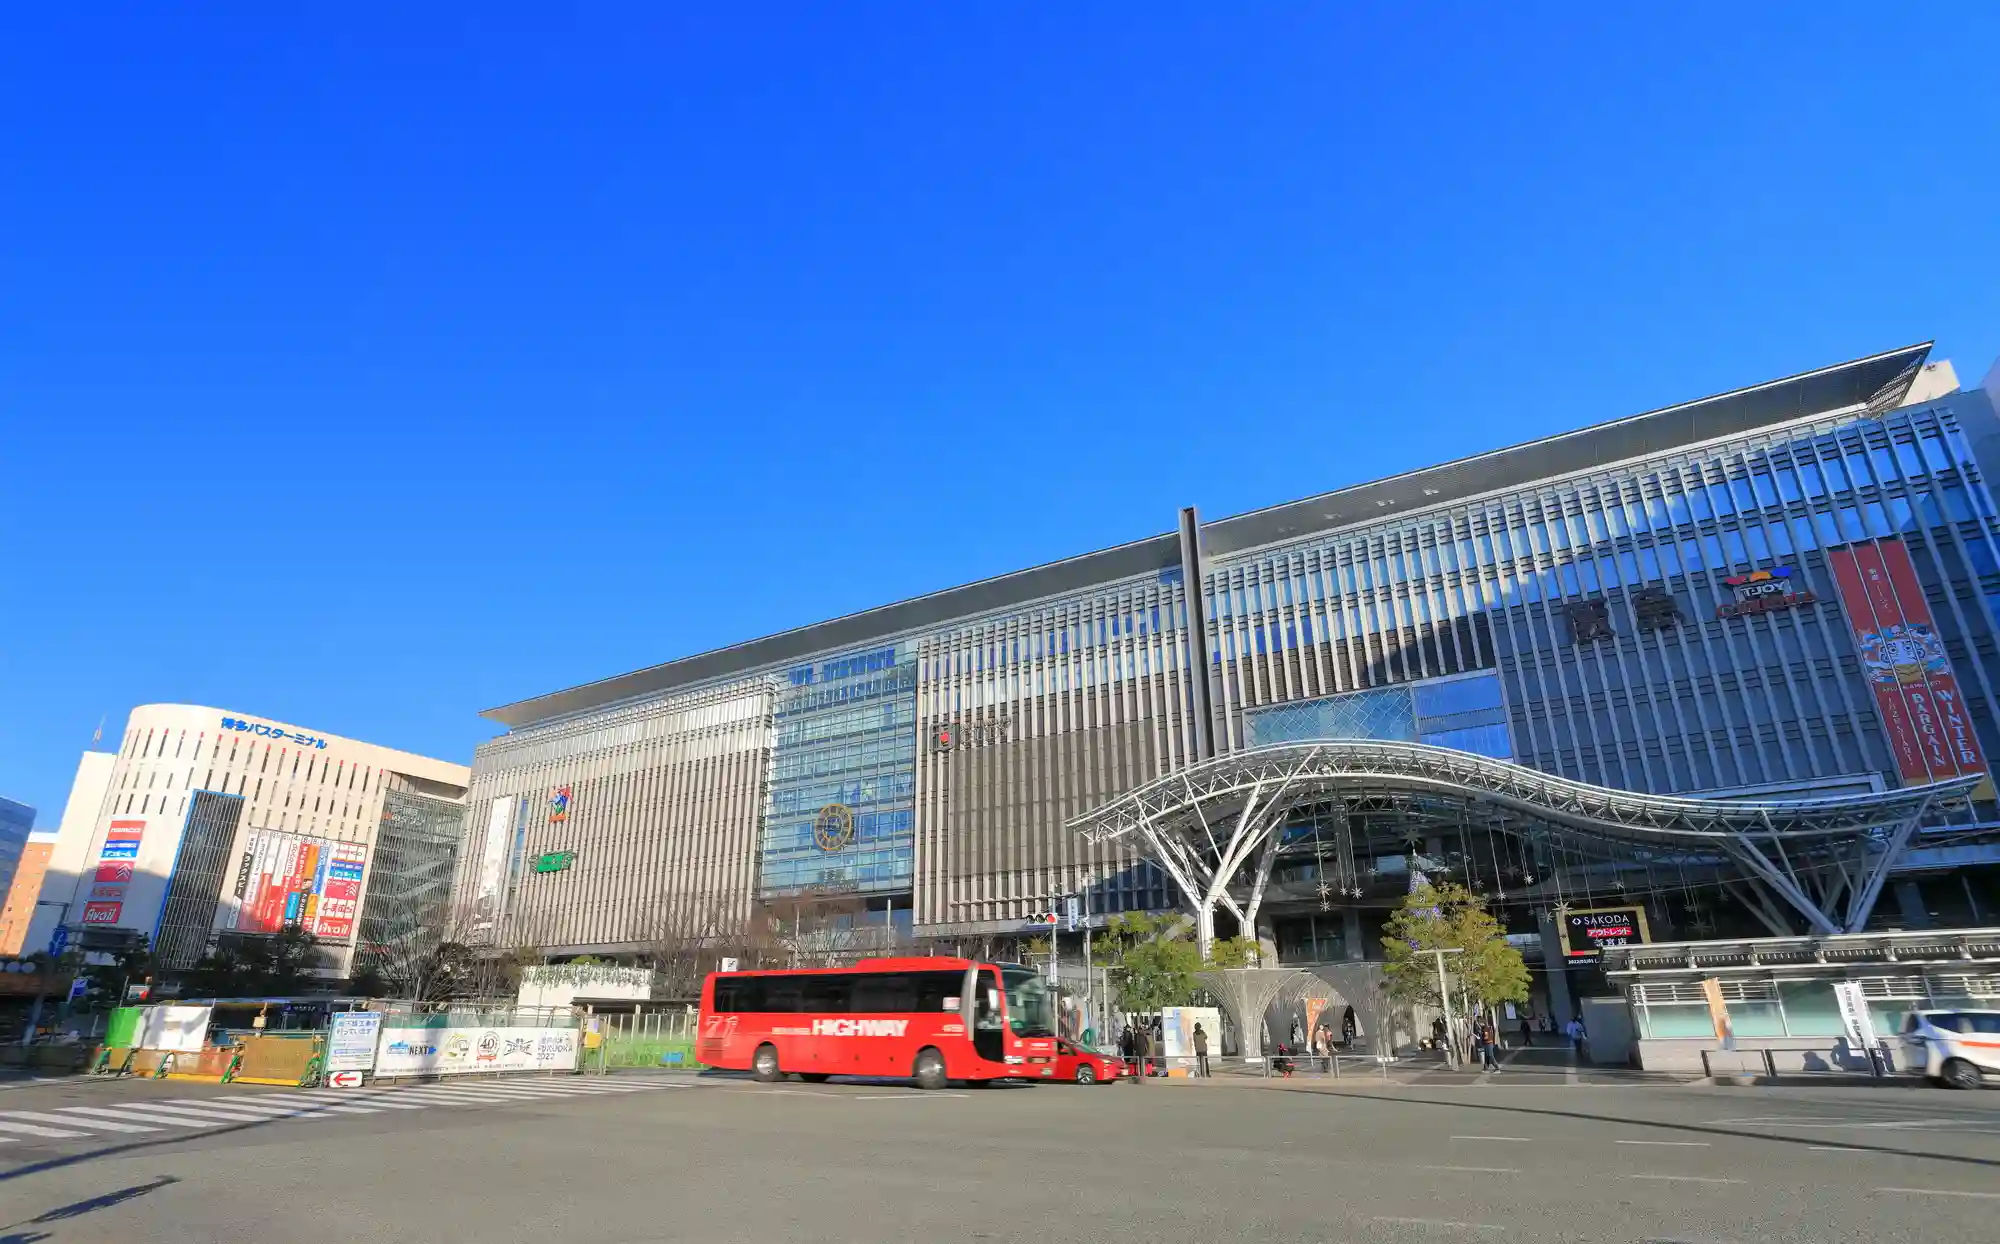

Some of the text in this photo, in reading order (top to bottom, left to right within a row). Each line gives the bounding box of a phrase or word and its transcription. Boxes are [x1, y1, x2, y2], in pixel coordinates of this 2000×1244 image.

[221, 716, 327, 749] 博多バスターミナル
[1911, 693, 1945, 767] BARGAIN
[1936, 689, 1976, 764] WINTER
[85, 907, 117, 921] Avail
[1584, 914, 1630, 925] SAKODA
[1588, 927, 1632, 937] アウトレット
[812, 1019, 909, 1037] HIGHWAY
[409, 1046, 429, 1056] NEXT
